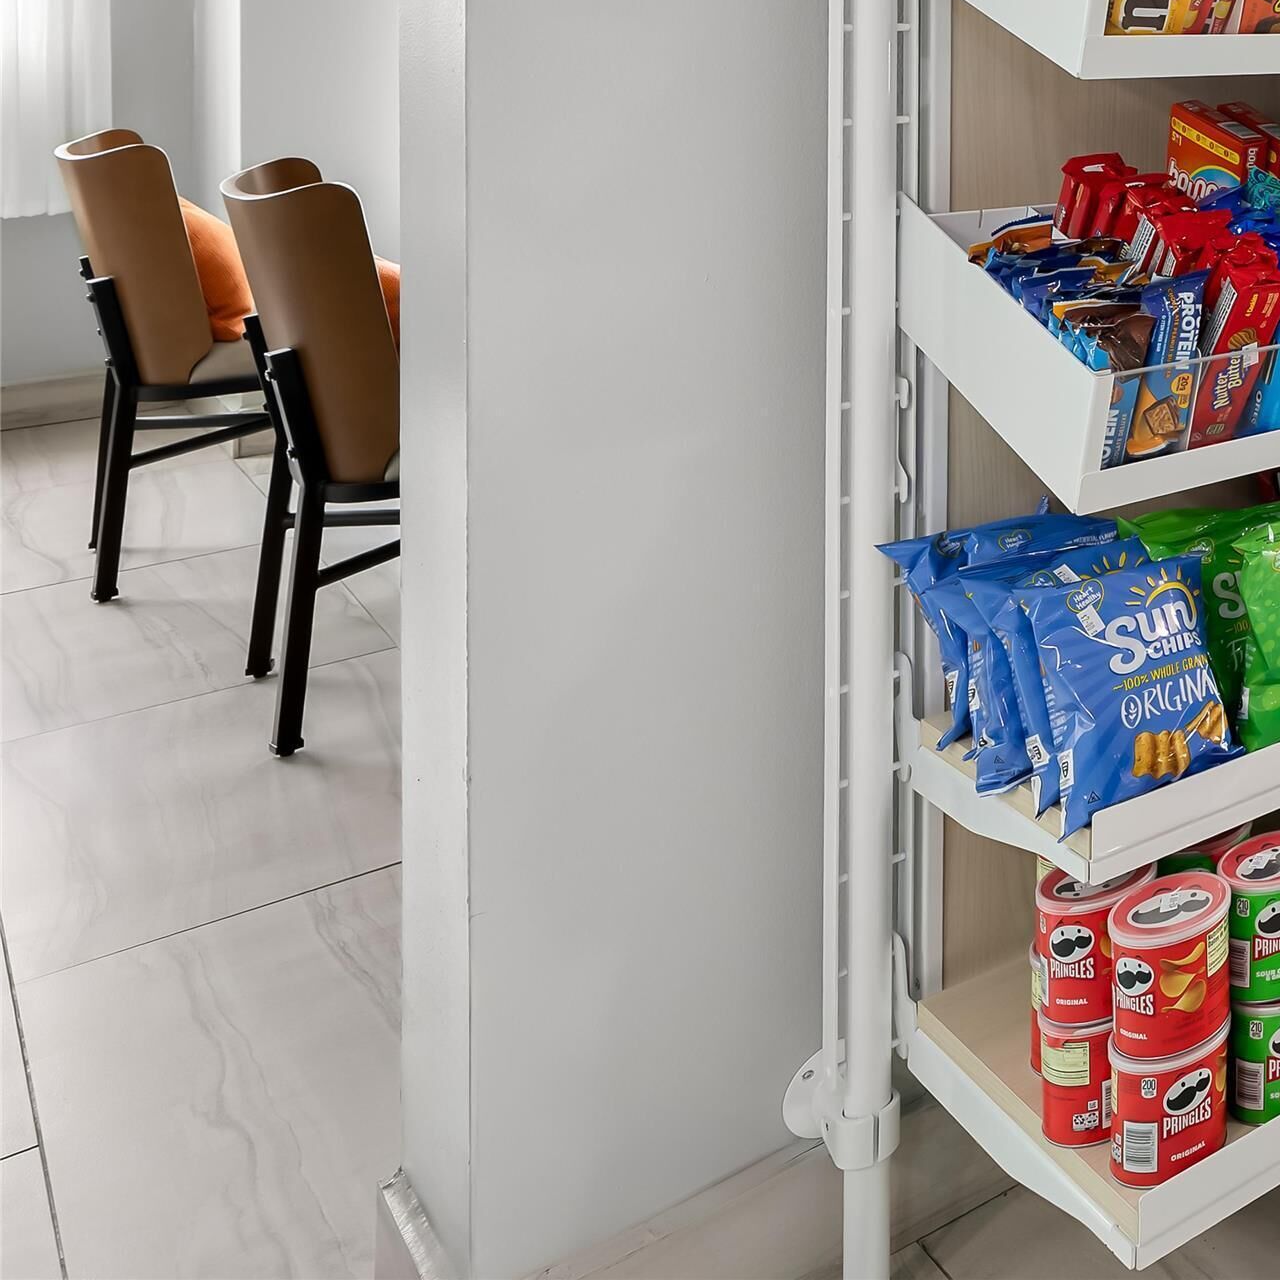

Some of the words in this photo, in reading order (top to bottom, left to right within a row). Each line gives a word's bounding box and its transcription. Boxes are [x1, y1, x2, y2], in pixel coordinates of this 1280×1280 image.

[1175, 291, 1195, 370] PROTEIN
[1227, 353, 1243, 389] Butter
[1179, 375, 1191, 391] 20g
[1214, 371, 1229, 409] Nutter
[1072, 586, 1094, 603] Heart
[1075, 591, 1101, 610] Healthy
[1105, 598, 1199, 675] Sun
[1148, 632, 1201, 660] CHIPS
[1122, 675, 1149, 691] 100%
[1150, 663, 1181, 683] WHOLE
[1182, 654, 1208, 673] GRAIN
[1237, 899, 1249, 910] 210
[1050, 957, 1094, 980] PRINGLES
[1255, 969, 1274, 978] SOUR
[1055, 997, 1088, 1006] ORIGINAL
[1115, 985, 1154, 1015] PRINGLES
[1119, 1027, 1148, 1040] ORIGINAL
[1250, 1021, 1262, 1033] 210
[1142, 1078, 1156, 1092] 200
[1163, 1099, 1211, 1139] PRINGLES
[1170, 1141, 1206, 1162] ORIGINAL
